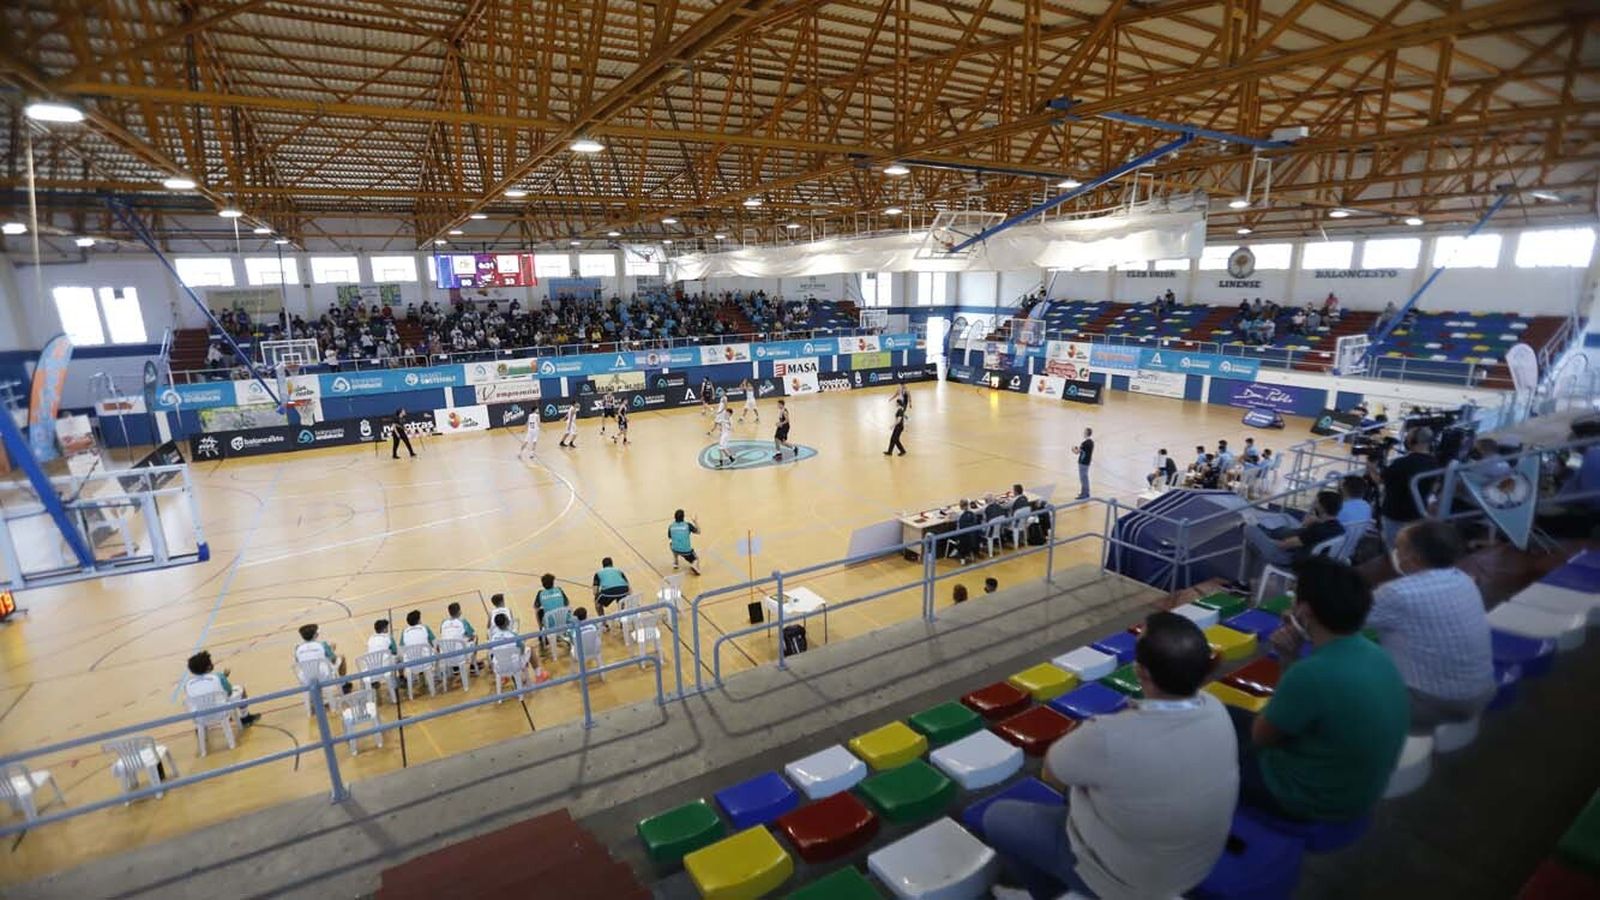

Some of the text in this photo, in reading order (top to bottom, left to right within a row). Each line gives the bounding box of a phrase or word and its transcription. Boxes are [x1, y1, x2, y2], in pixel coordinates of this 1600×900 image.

[1315, 269, 1397, 279] BALONCESTO
[1218, 280, 1261, 289] LINENSE
[788, 362, 818, 374] MASA
